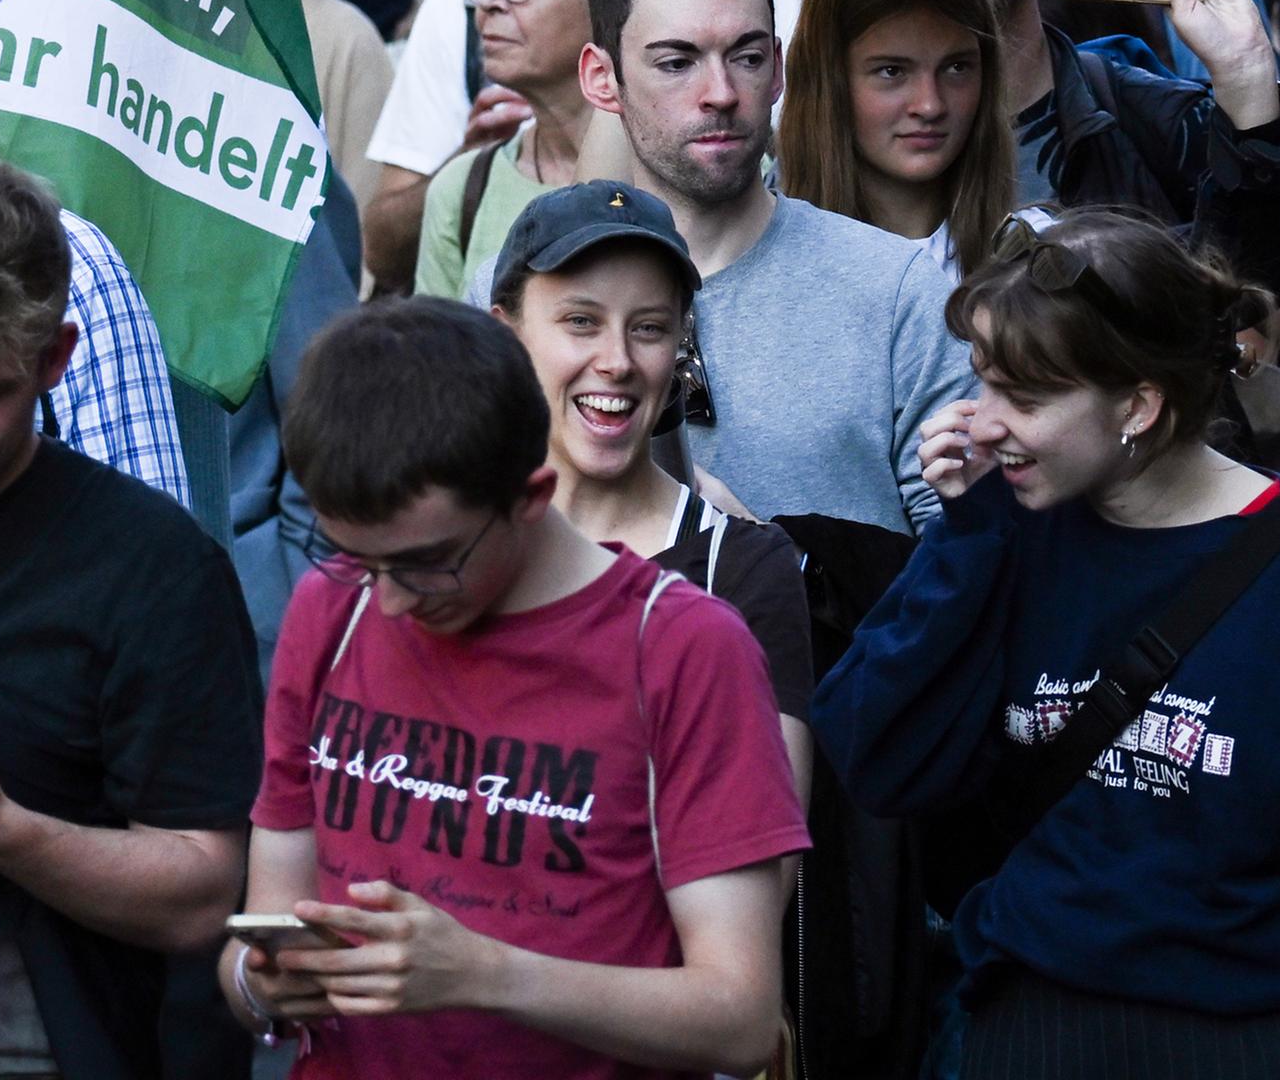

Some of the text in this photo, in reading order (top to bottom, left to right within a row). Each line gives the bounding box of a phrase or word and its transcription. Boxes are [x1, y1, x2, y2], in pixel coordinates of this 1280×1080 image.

[1034, 673, 1069, 696] Basic
[1164, 696, 1217, 716] concept
[345, 749, 365, 780] &
[370, 754, 468, 802] Reggae
[476, 774, 595, 823] Festival
[1104, 774, 1128, 788] just
[1133, 777, 1148, 791] for
[1152, 784, 1171, 798] you
[1133, 756, 1191, 794] FEELING
